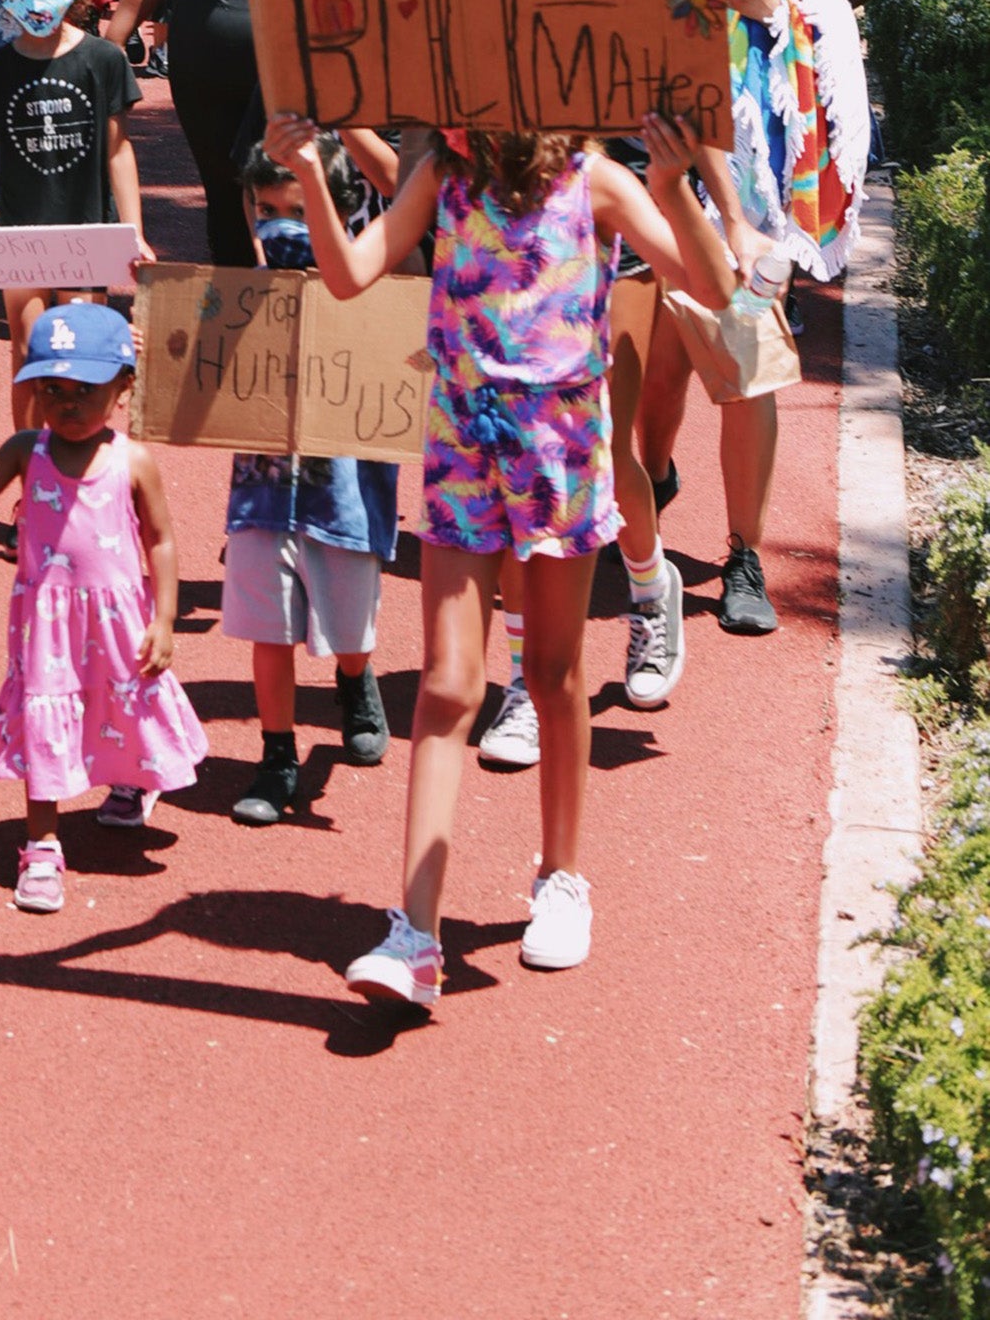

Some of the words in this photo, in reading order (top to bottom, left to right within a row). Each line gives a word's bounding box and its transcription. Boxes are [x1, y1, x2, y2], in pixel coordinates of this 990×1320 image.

[26, 97, 72, 117] STRONG
[43, 115, 57, 135] &
[63, 233, 89, 257] is
[49, 318, 77, 351] LA
